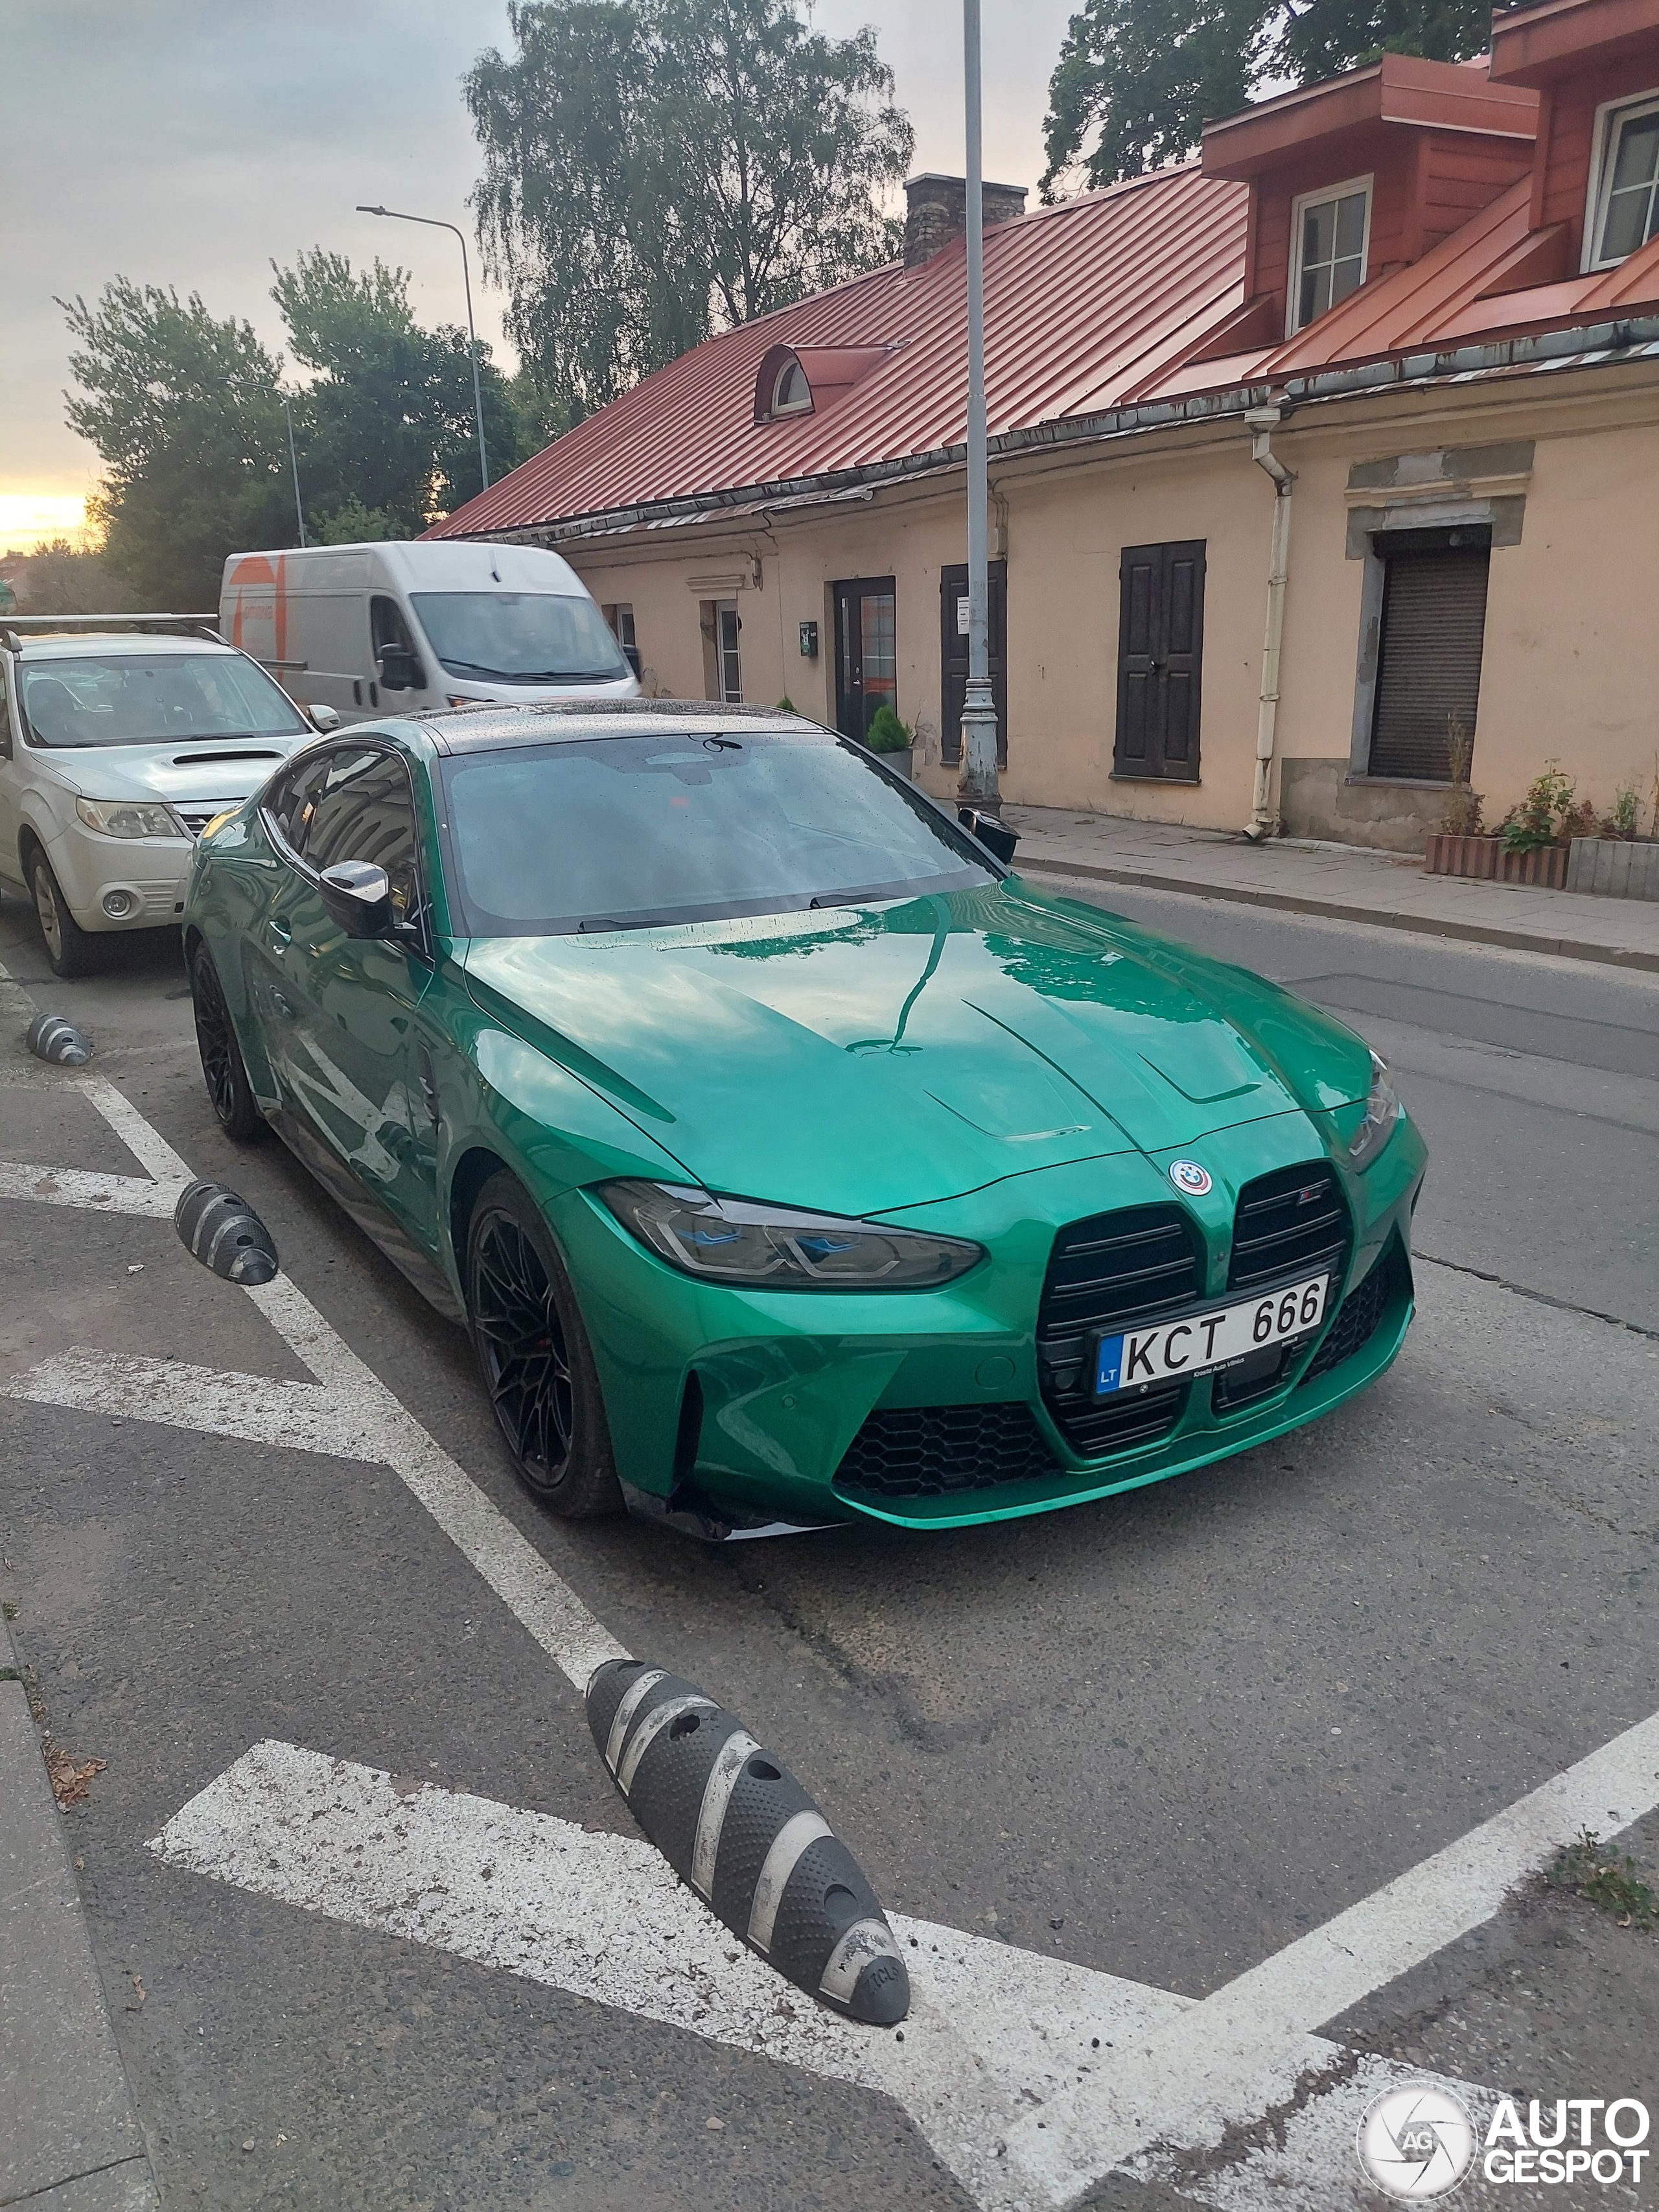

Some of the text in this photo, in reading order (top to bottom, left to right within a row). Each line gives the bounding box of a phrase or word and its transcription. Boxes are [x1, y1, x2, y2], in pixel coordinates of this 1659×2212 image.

[1126, 1283, 1320, 1380] KCT 666
[1100, 1368, 1117, 1383] LT
[1212, 1364, 1226, 1372] Auto
